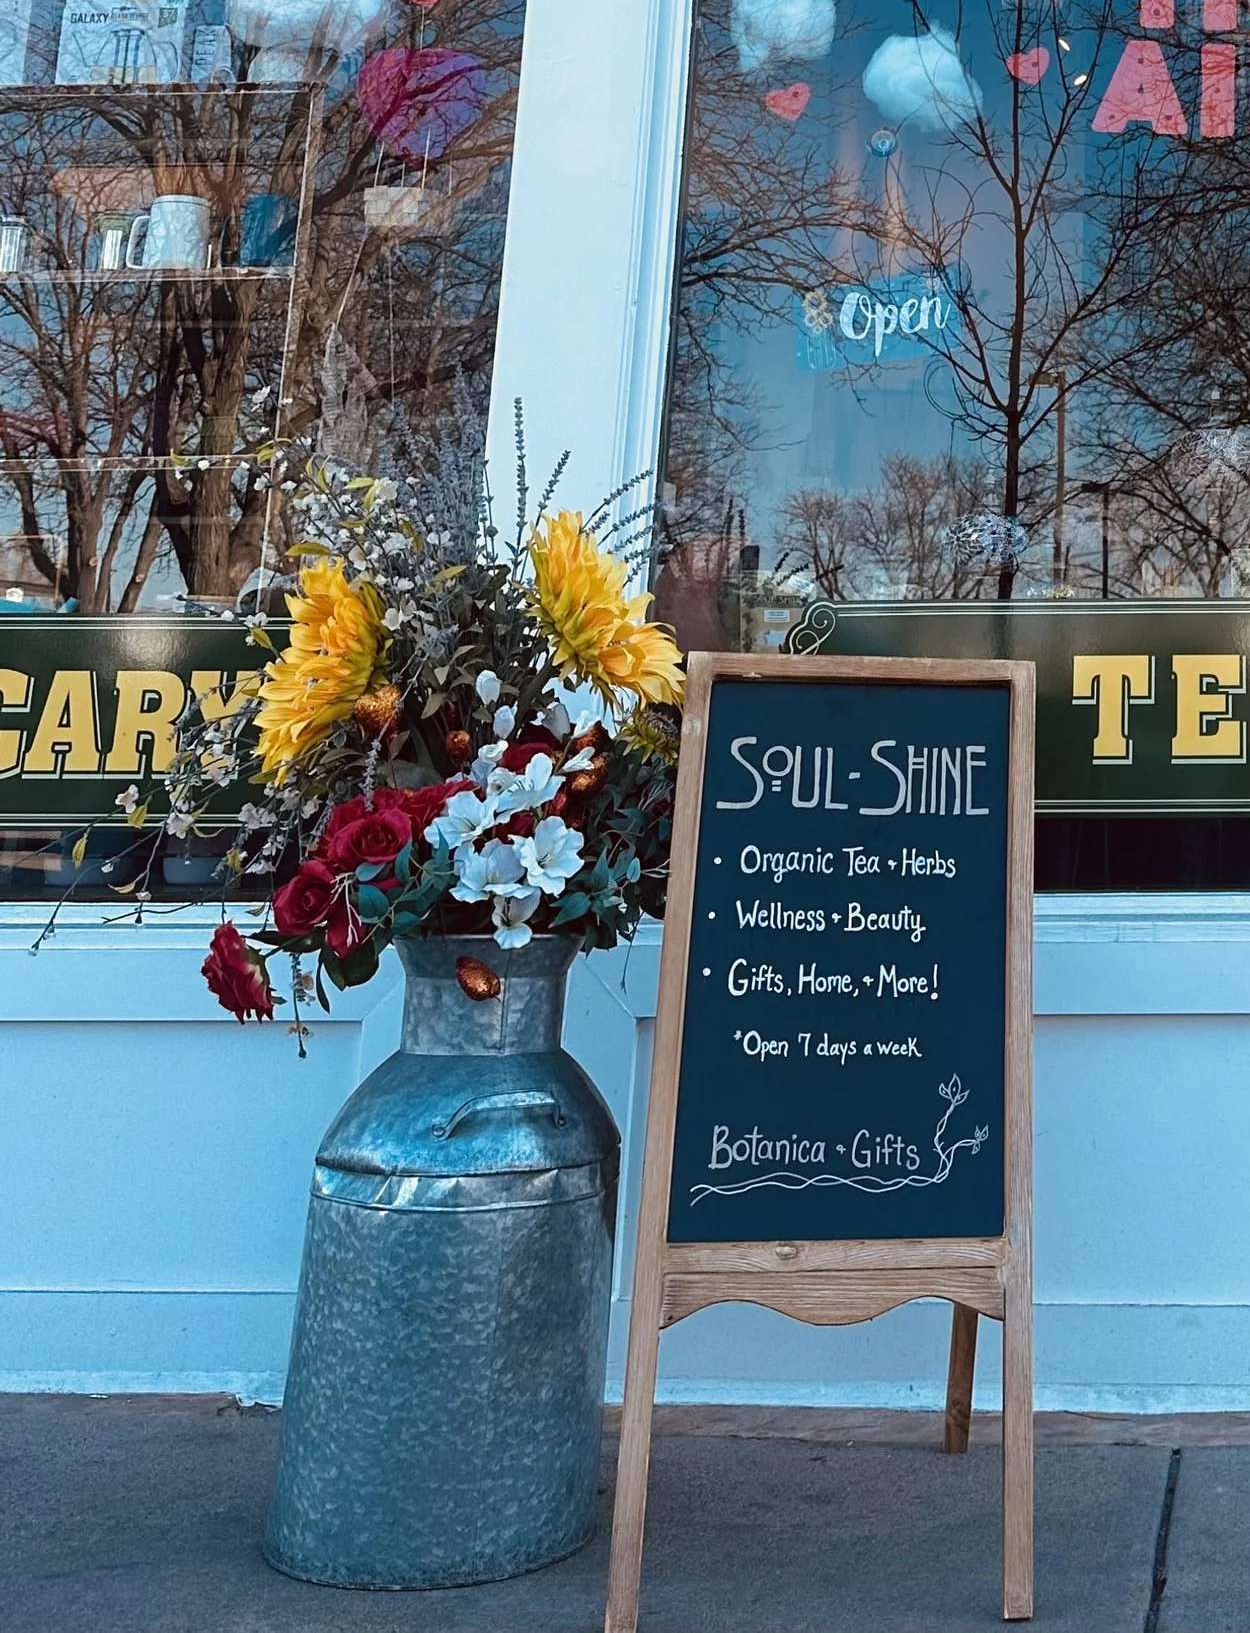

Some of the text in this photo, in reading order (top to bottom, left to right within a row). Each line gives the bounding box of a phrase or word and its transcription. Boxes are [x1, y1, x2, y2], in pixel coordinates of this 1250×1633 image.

[70, 12, 109, 24] GALAXY
[194, 24, 218, 67] PEAK
[839, 291, 951, 358] Open
[740, 844, 834, 884] Organic
[842, 846, 881, 877] Tea
[901, 847, 956, 879] Herbs
[735, 898, 826, 932] Wellness
[843, 902, 927, 943] Beauty
[727, 957, 792, 998] Gifts,
[797, 962, 859, 999] Home,
[876, 963, 939, 1001] More!
[797, 1032, 812, 1058] 7
[816, 1032, 857, 1066] days
[863, 1043, 873, 1056] a
[707, 1124, 826, 1170] Botanica
[851, 1128, 921, 1171] Gifts
